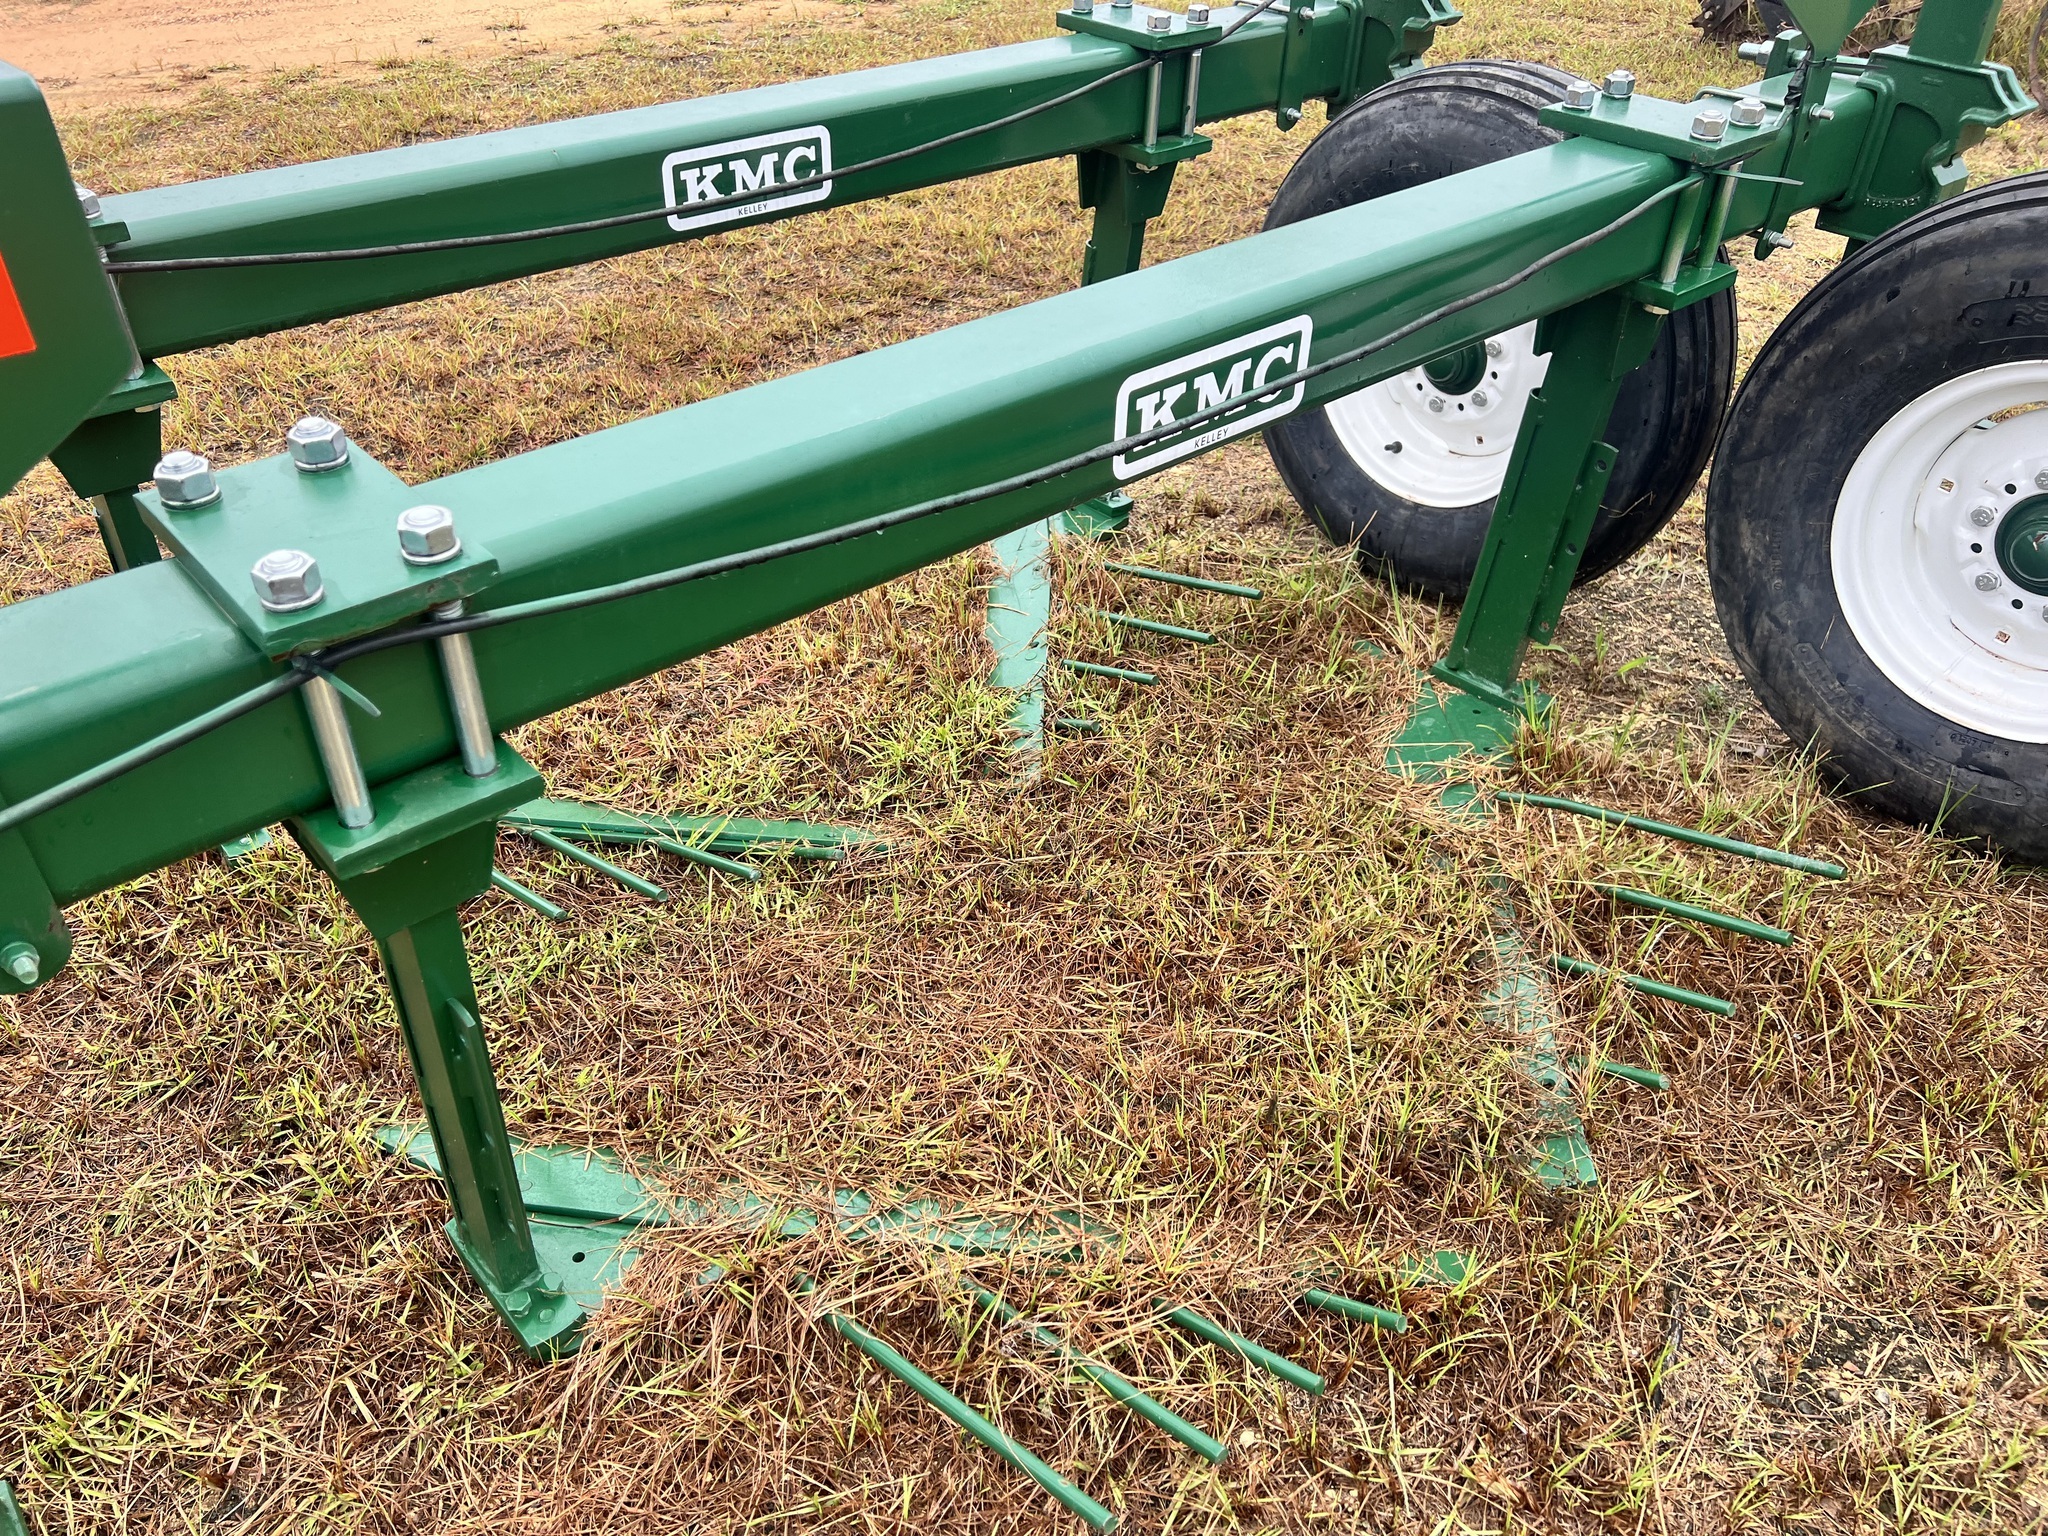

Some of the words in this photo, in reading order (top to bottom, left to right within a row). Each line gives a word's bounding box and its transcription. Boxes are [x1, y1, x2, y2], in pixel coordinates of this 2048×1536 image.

[680, 145, 816, 205] KMC
[738, 202, 768, 216] KELLEY
[1133, 343, 1294, 452] KMC
[1194, 427, 1229, 449] KELLEY
